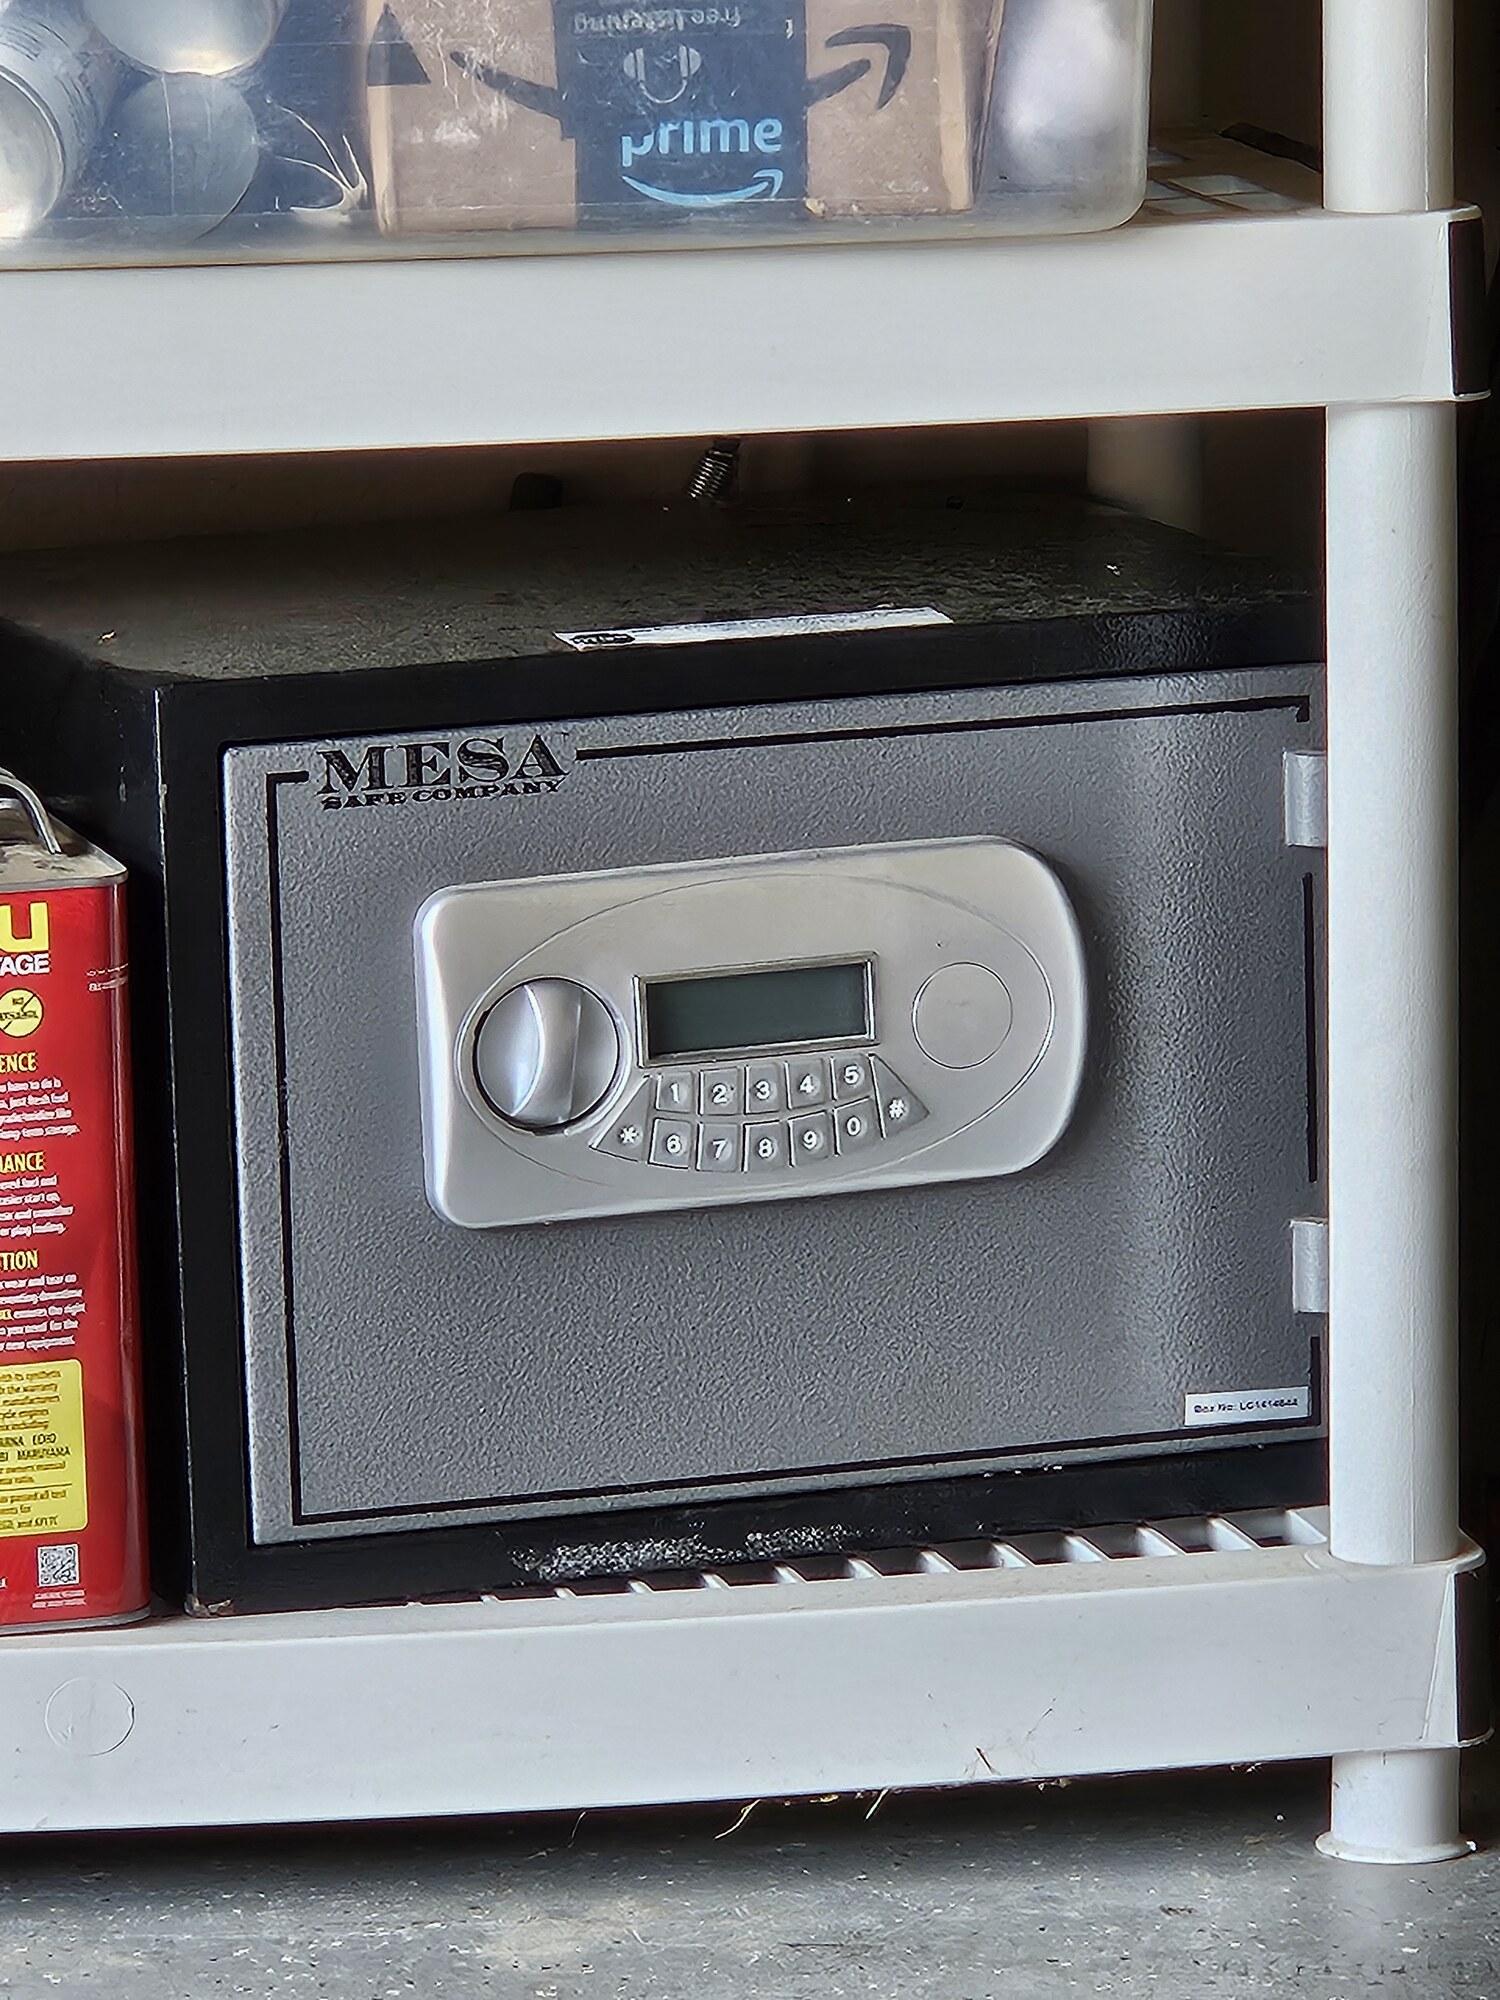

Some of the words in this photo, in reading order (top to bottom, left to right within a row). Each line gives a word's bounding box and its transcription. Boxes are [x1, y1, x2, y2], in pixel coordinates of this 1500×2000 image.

[621, 118, 783, 168] prime
[316, 734, 570, 796] MESA
[321, 791, 407, 811] SAFE
[412, 776, 566, 803] COMPANY
[0, 952, 51, 976] AGE
[668, 1083, 681, 1104] 1
[712, 1084, 730, 1104] 2
[755, 1081, 772, 1100] 3
[799, 1074, 815, 1095] 4
[844, 1065, 860, 1085] 5
[666, 1134, 682, 1154] 6
[712, 1139, 727, 1160] 7
[758, 1138, 774, 1158] 8
[803, 1130, 819, 1150] 9
[846, 1117, 862, 1136] 0
